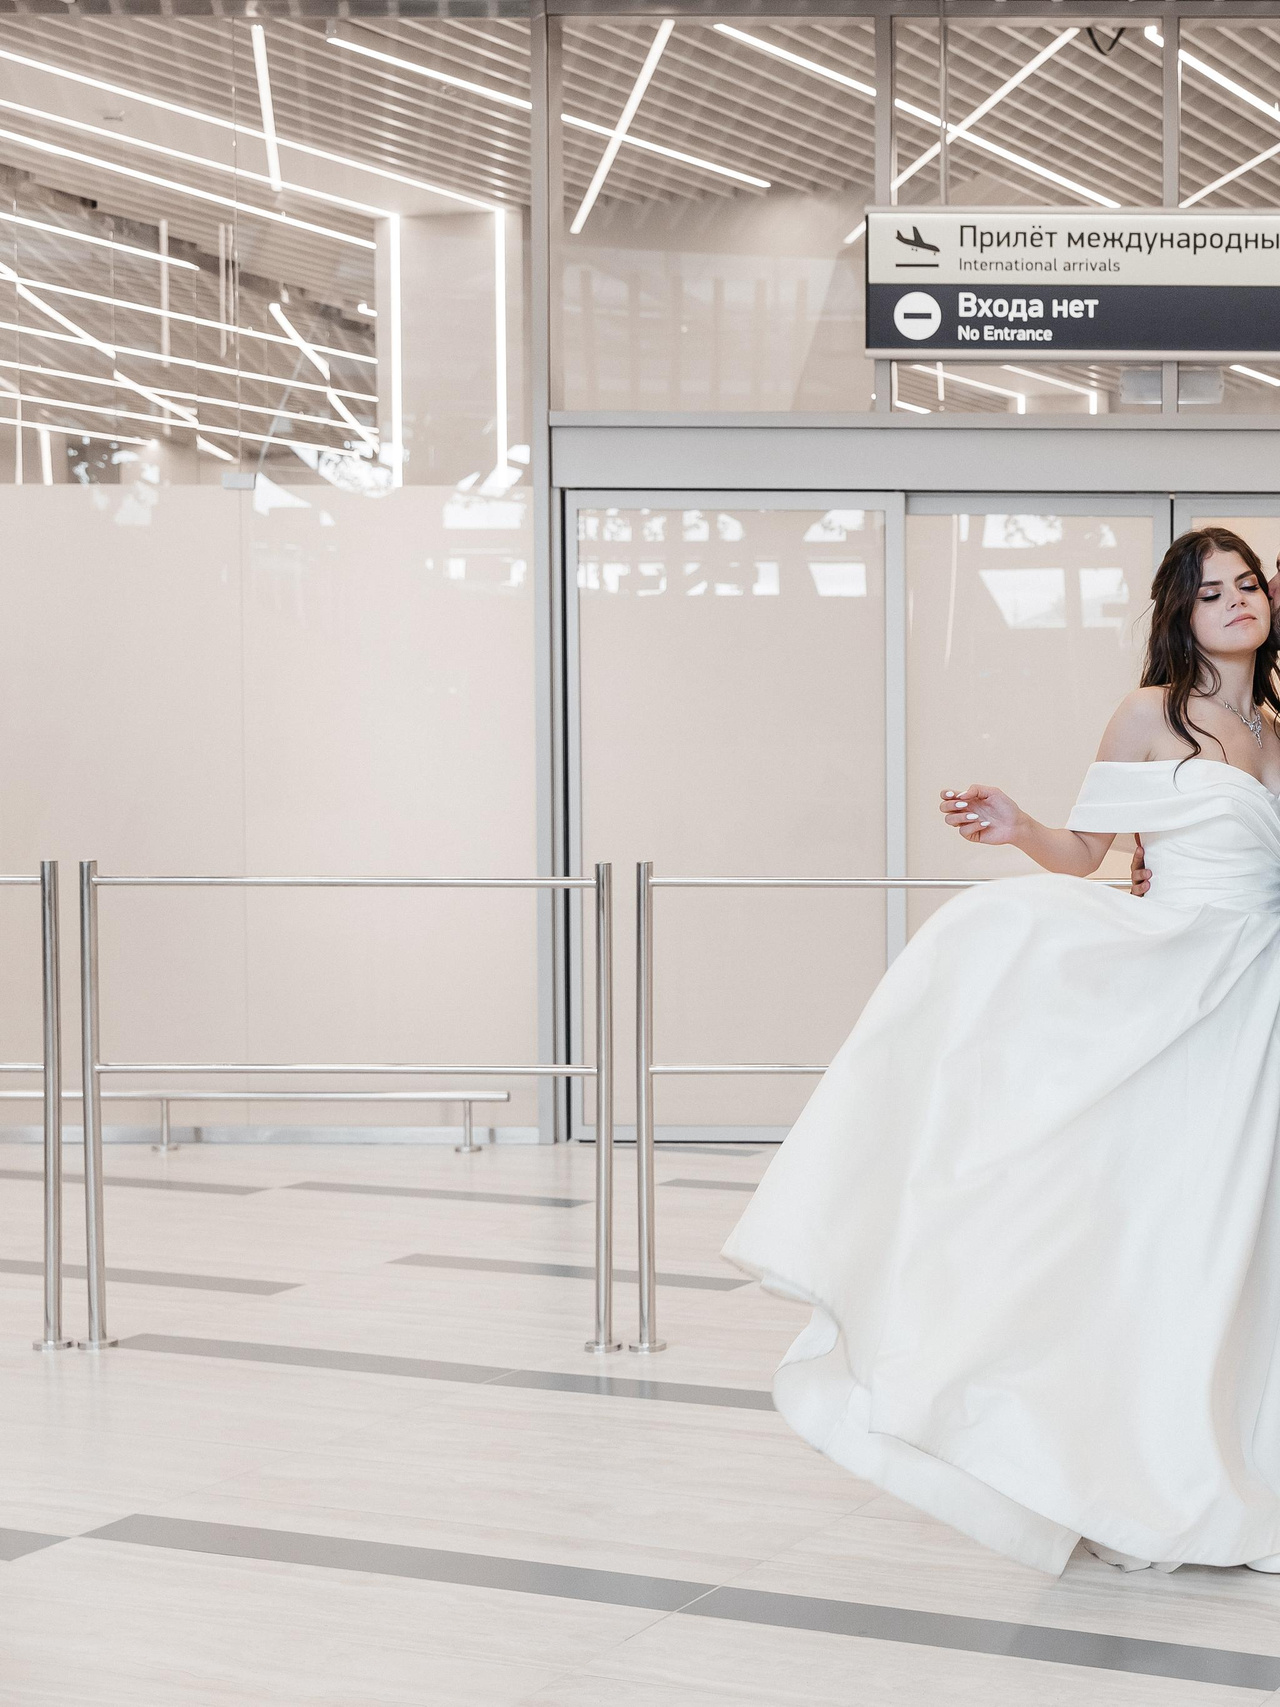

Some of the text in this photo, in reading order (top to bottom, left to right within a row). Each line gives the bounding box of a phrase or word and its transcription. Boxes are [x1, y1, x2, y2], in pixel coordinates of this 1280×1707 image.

[959, 224, 1057, 254] Прилёт
[959, 257, 1121, 272] International arrivals
[958, 292, 1100, 321] Входа нет
[957, 325, 1053, 342] No Entrance
